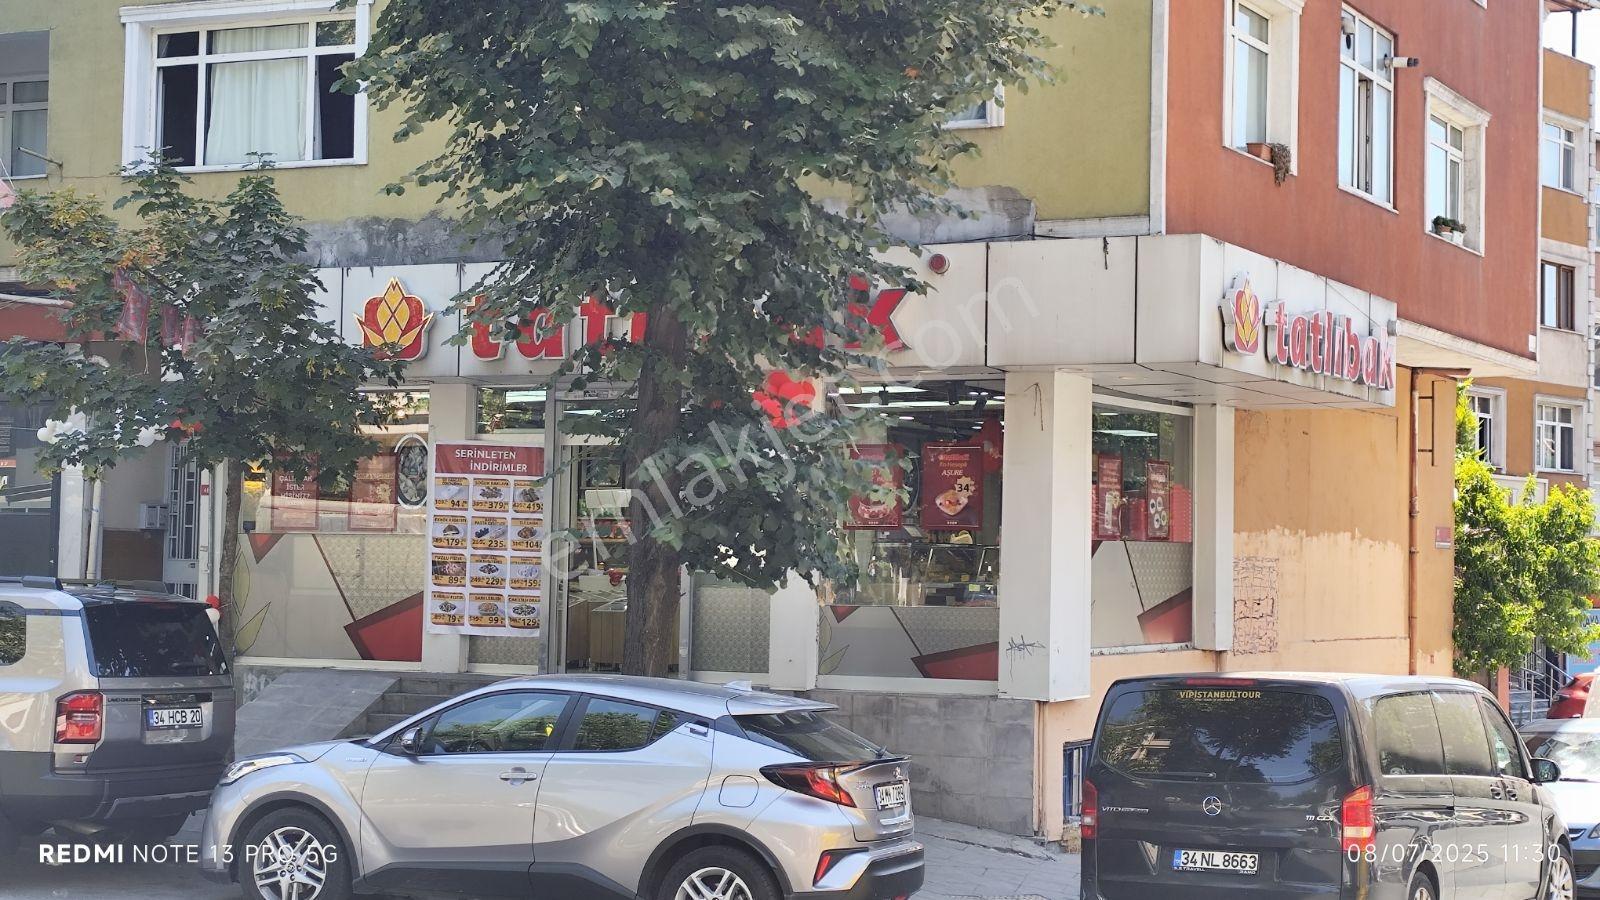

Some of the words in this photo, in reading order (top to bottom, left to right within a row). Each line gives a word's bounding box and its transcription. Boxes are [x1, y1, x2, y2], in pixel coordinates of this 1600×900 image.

[455, 448, 516, 459] SERİNLETEN
[470, 460, 527, 472] İNDİRİMLER
[956, 484, 970, 492] 34
[153, 711, 165, 725] 34
[167, 710, 188, 724] HCB
[190, 709, 201, 723] 20
[1181, 851, 1198, 866] 34
[1200, 852, 1220, 868] NL
[1222, 853, 1258, 870] 8663
